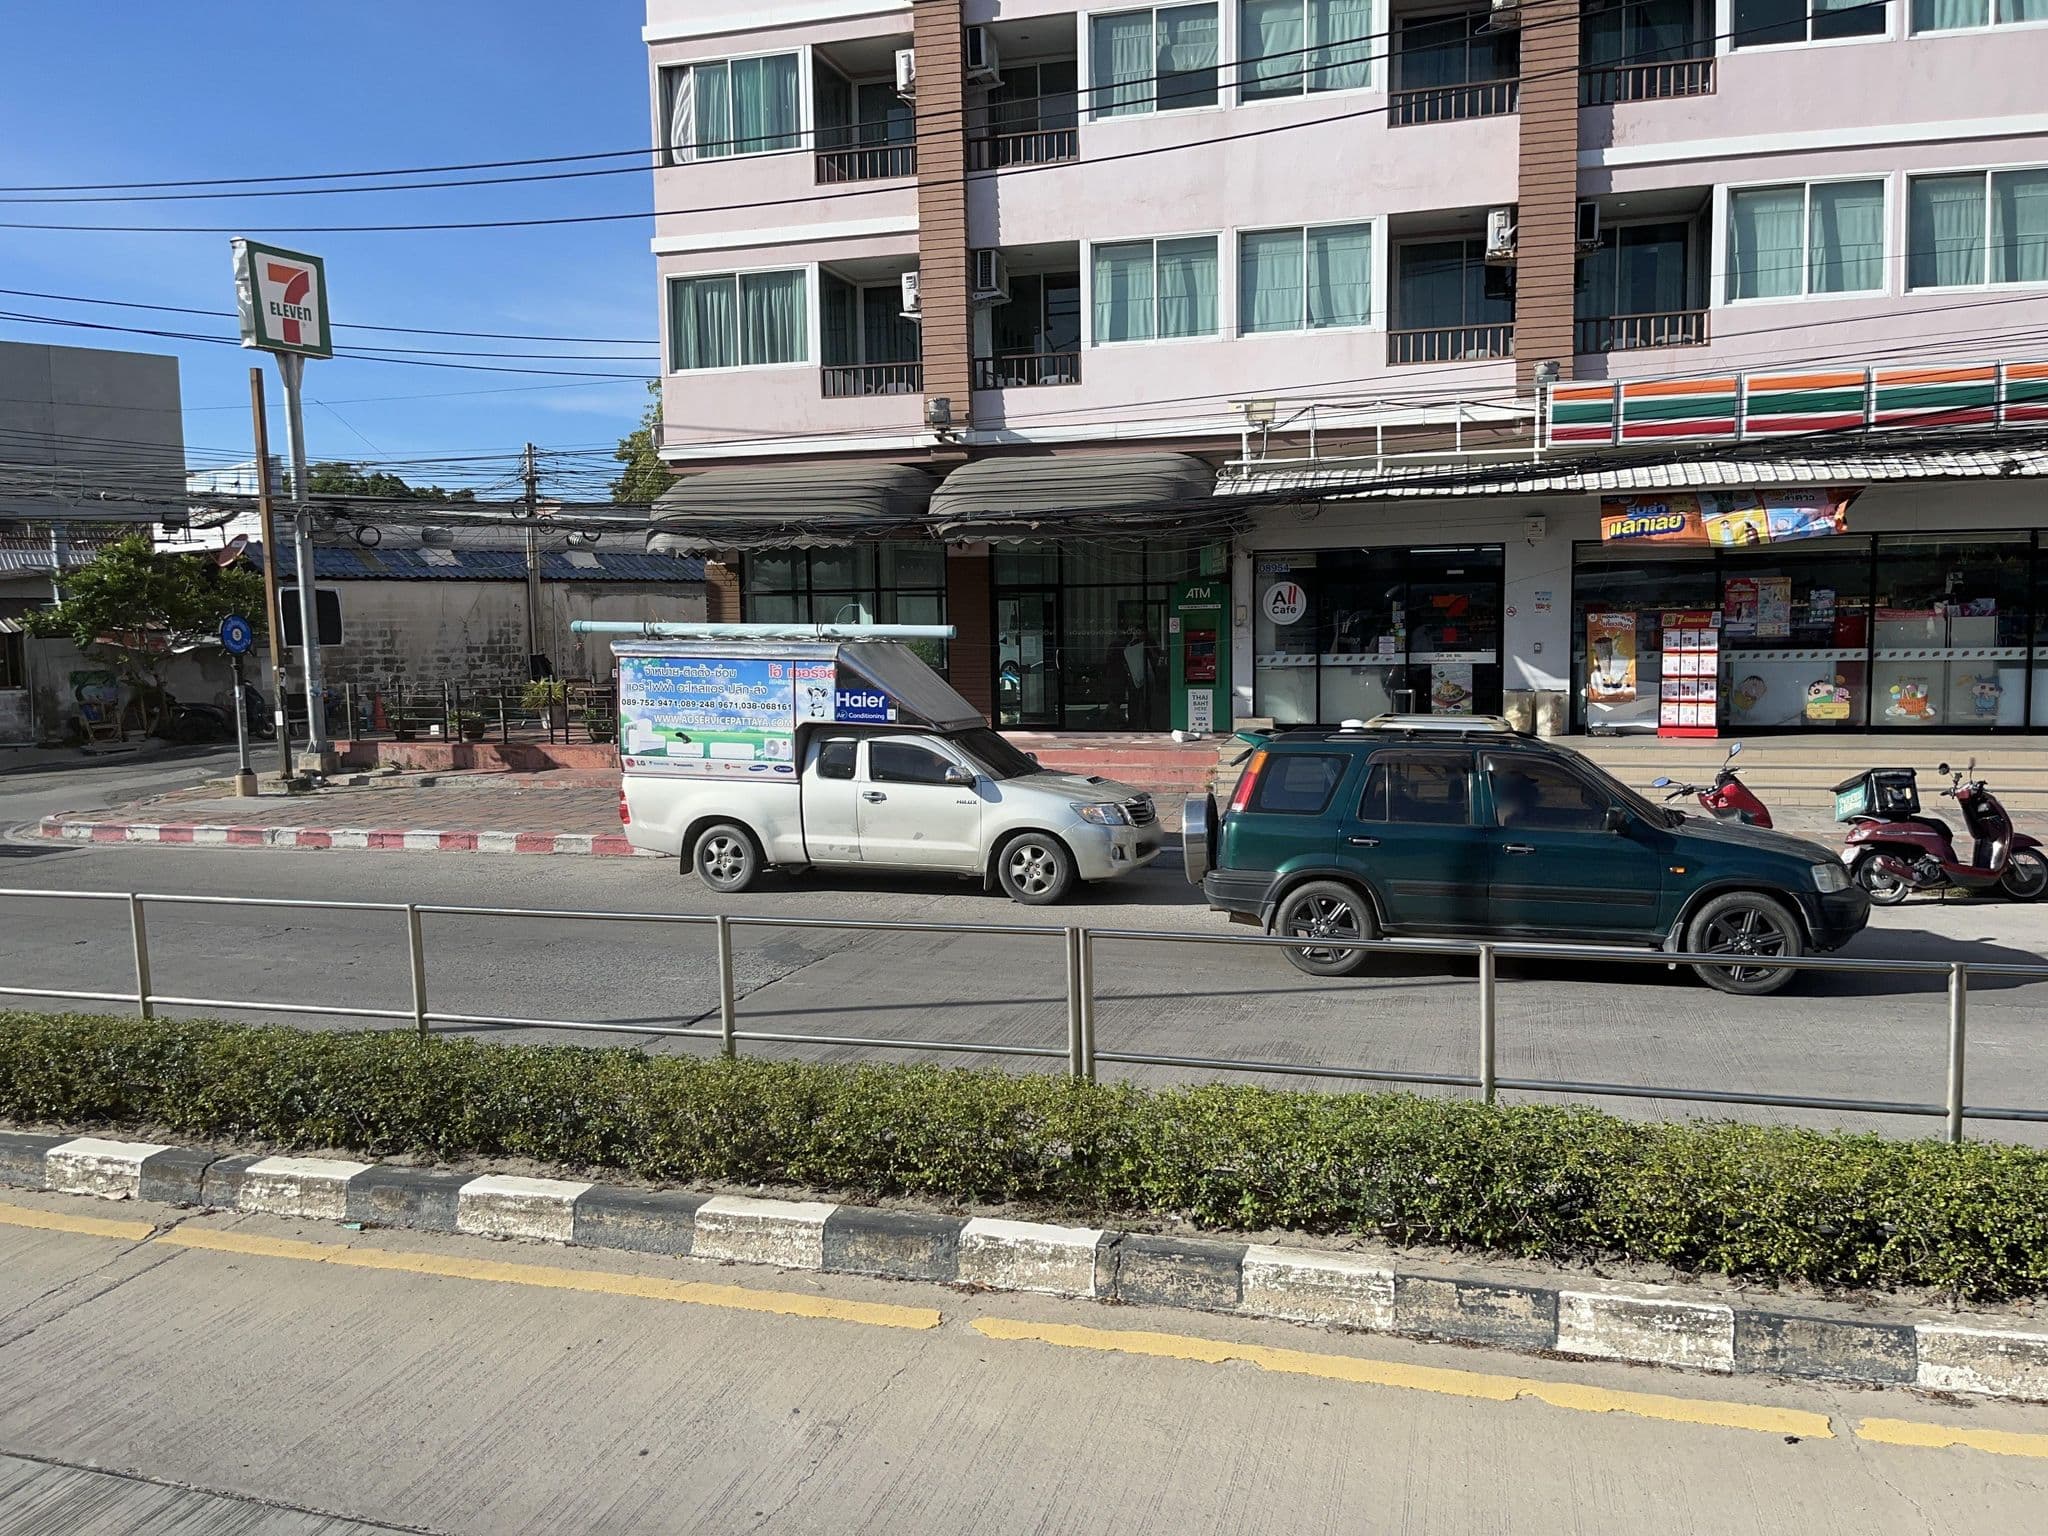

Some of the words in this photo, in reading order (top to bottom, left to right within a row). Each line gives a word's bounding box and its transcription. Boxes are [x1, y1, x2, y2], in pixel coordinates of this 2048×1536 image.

[267, 262, 310, 345] 7
[1609, 513, 1685, 537] แลกเลย
[1185, 587, 1211, 600] ATM
[1272, 585, 1298, 606] All
[835, 691, 886, 708] Haier
